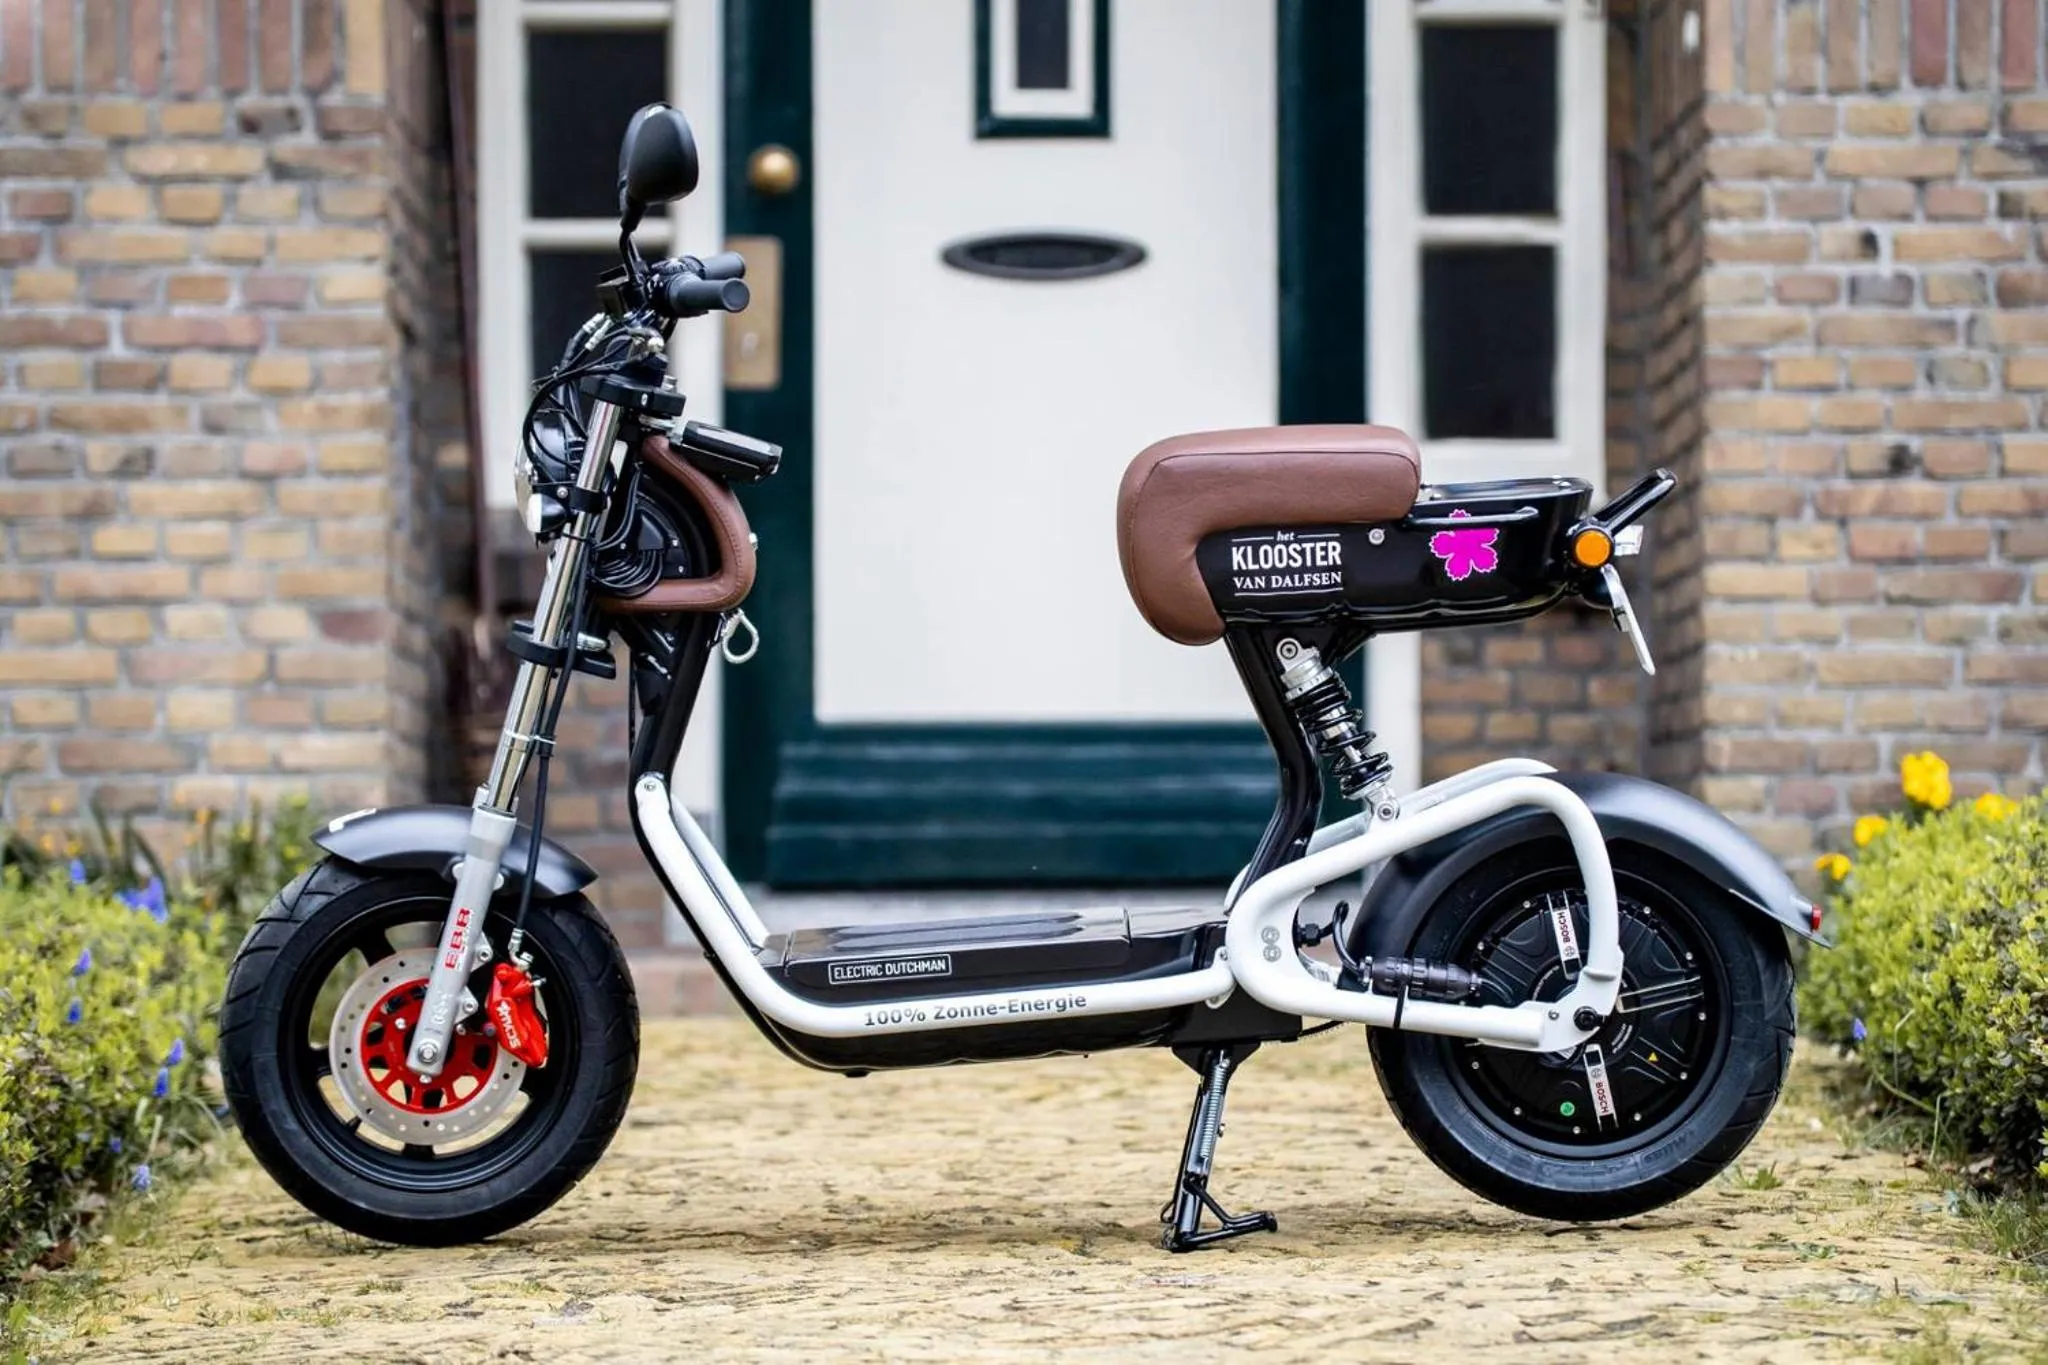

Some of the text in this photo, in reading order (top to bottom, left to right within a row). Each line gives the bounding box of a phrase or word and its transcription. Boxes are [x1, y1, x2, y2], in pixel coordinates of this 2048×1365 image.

[1276, 530, 1295, 541] het
[1231, 541, 1342, 570] KLOOSTER
[1233, 571, 1342, 589] VAN DALFSEN
[444, 908, 471, 970] EBR
[1556, 912, 1571, 943] BOSCH
[833, 959, 946, 980] ELECTRIC DUTCHMAN
[863, 994, 1087, 1026] 100% Zonne-Energie
[1595, 1082, 1609, 1113] BOSCH
